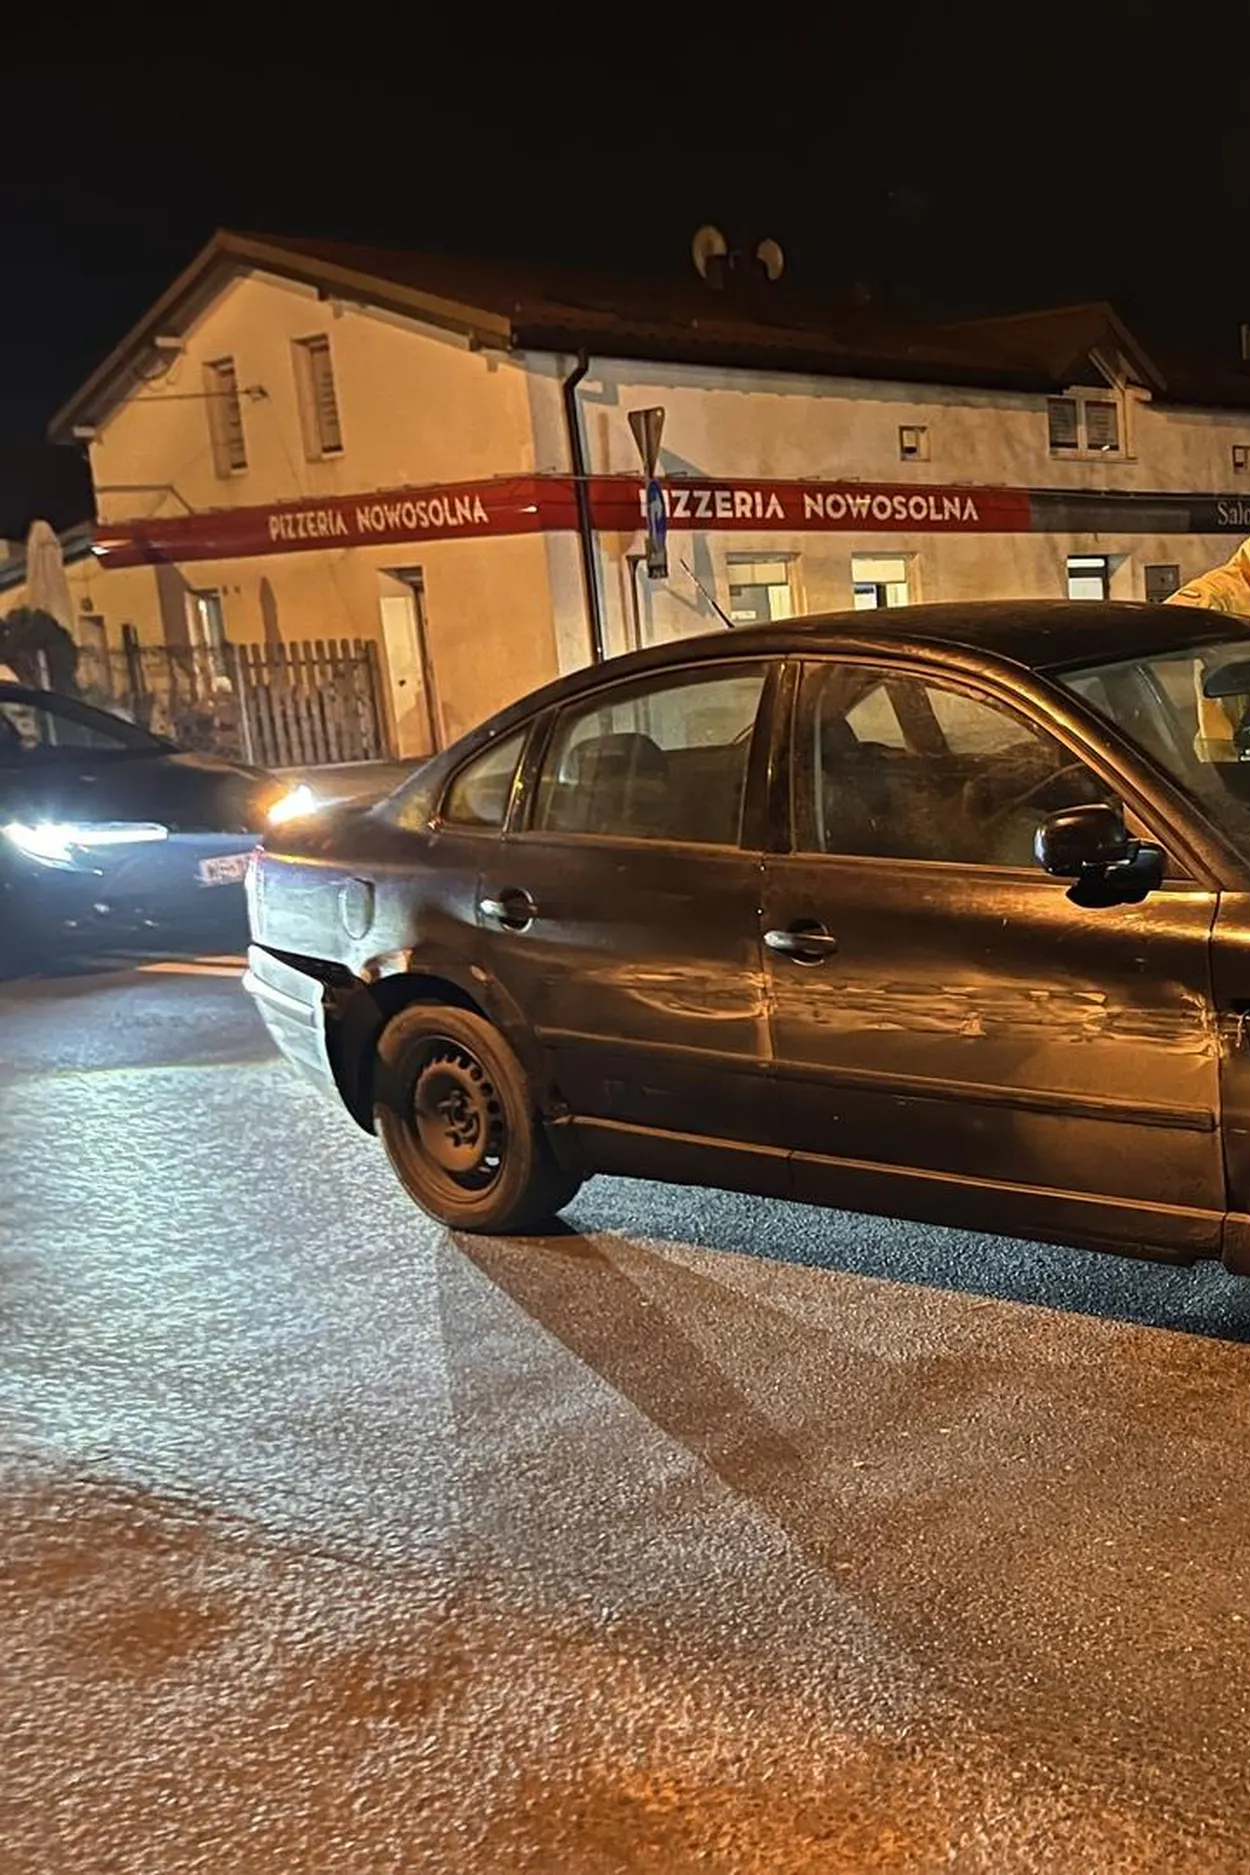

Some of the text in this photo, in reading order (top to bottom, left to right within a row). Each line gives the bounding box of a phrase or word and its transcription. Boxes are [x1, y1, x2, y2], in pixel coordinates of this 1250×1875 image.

[268, 496, 489, 541] PIZZERIA NOWOSOLNA
[804, 492, 979, 521] NOWOSOLNA
